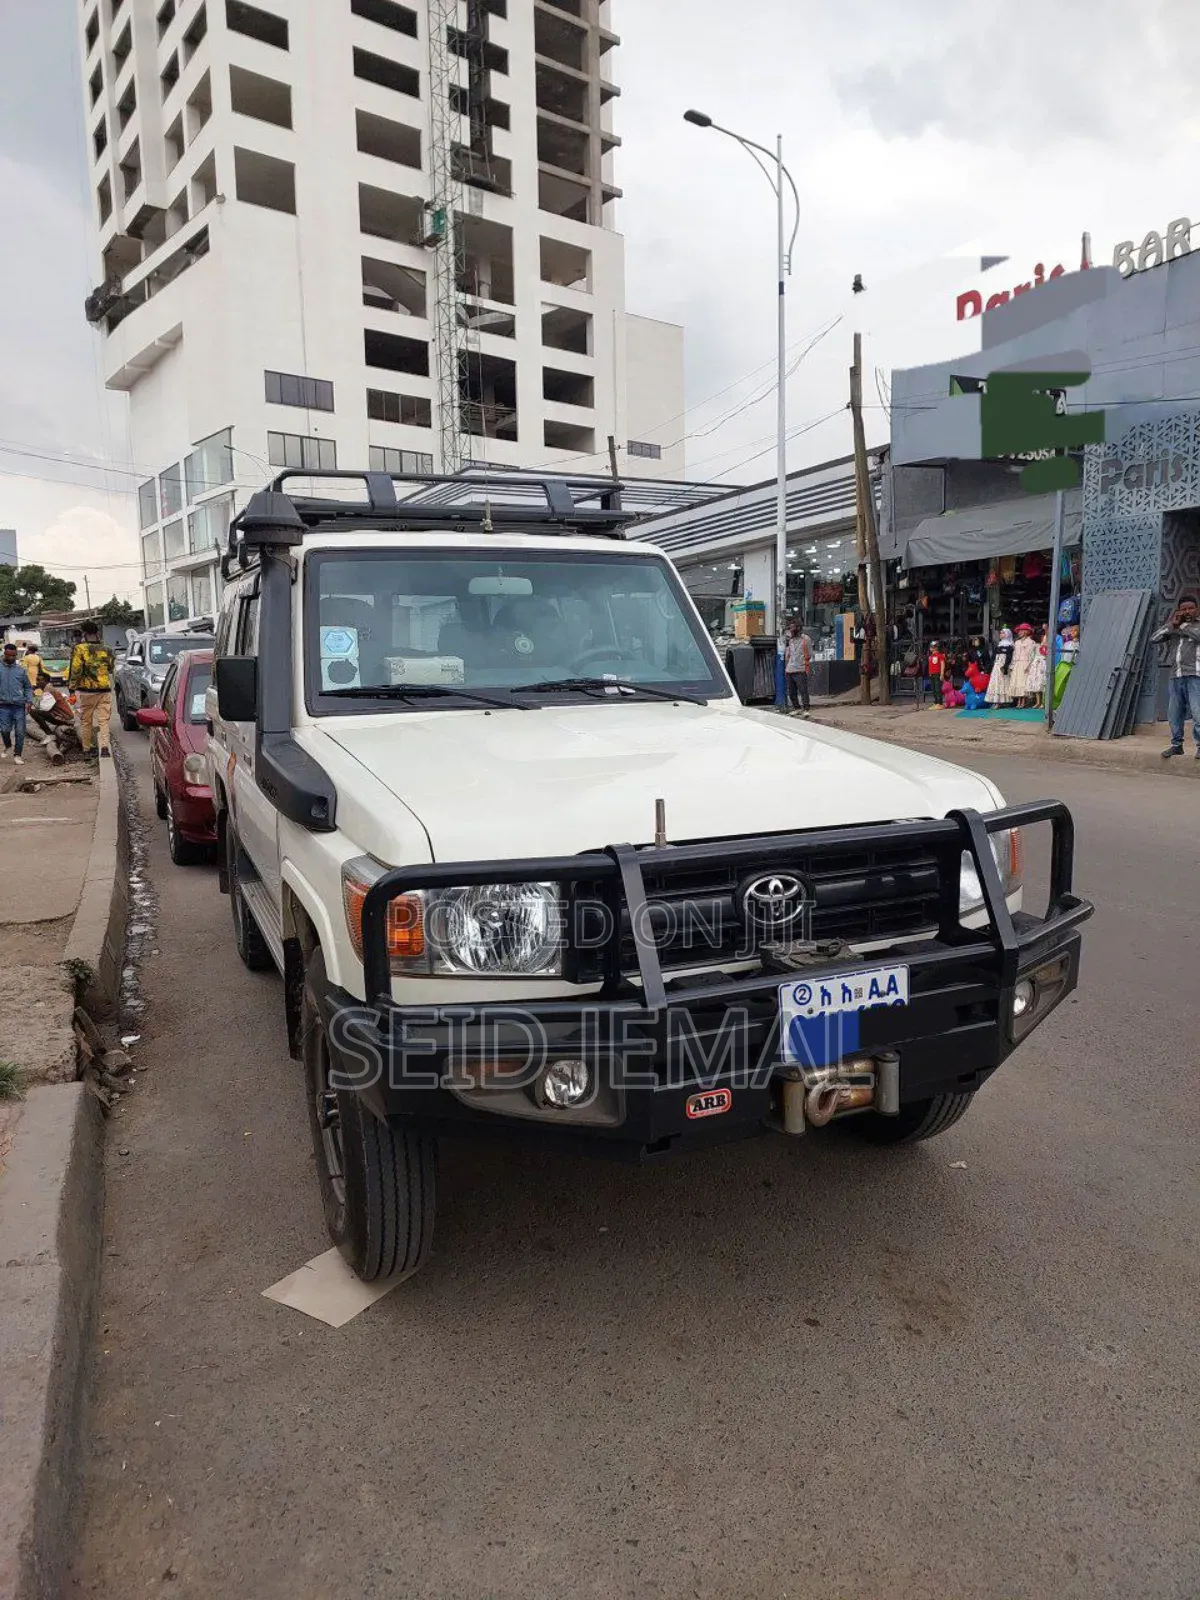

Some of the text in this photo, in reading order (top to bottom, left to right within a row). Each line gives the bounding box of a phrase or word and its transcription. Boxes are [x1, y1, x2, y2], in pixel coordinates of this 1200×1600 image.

[1113, 217, 1192, 278] BAR
[1100, 448, 1187, 495] Paris
[868, 974, 899, 1001] AA
[692, 1094, 727, 1112] ARB
